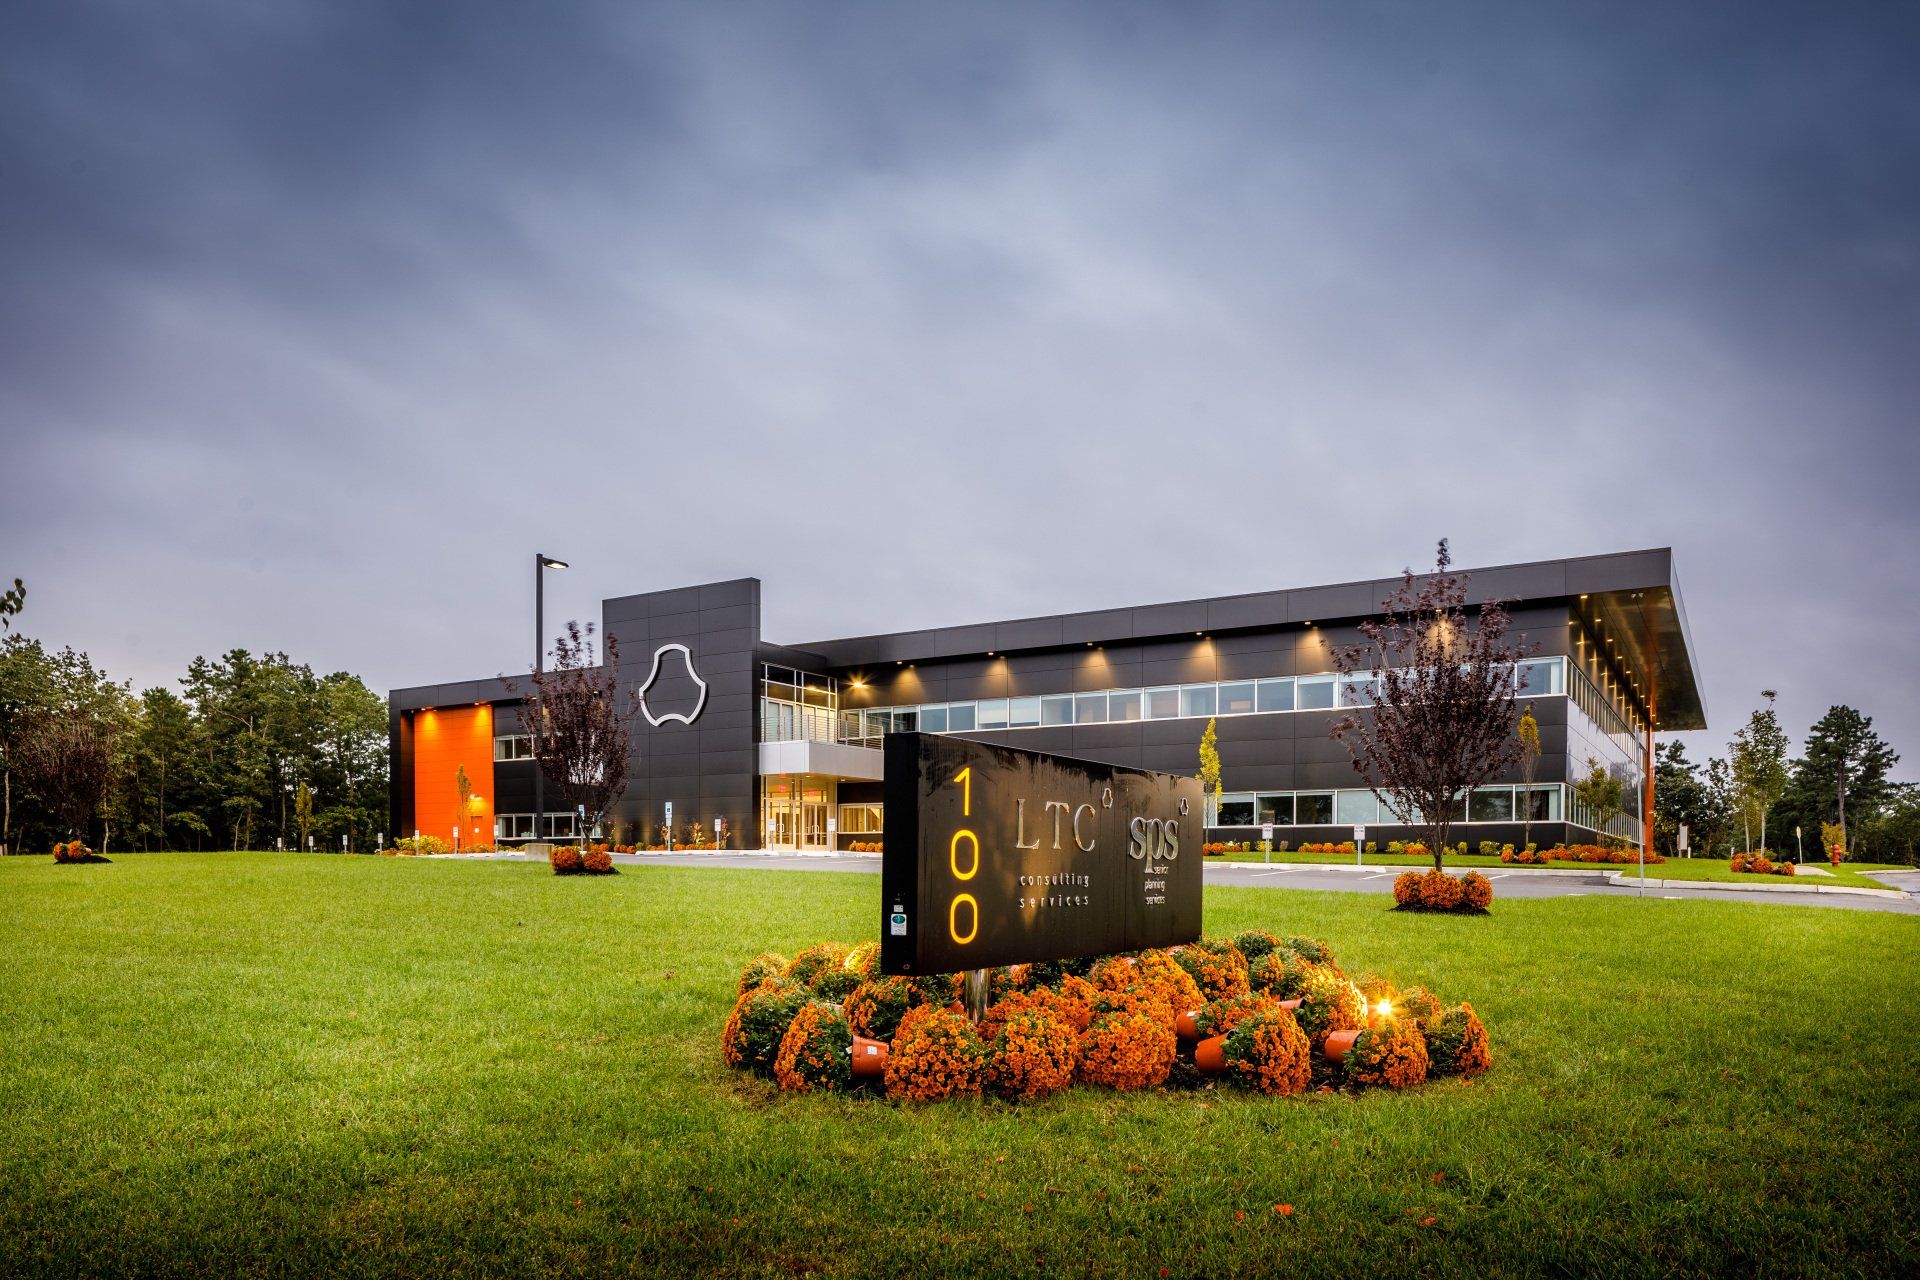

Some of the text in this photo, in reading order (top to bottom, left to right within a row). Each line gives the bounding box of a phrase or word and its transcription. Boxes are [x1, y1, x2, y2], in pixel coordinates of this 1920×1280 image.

[1016, 799, 1096, 852] LTC
[950, 768, 979, 944] 100
[1020, 873, 1089, 888] consulting
[1144, 879, 1166, 892] planning
[1019, 895, 1089, 909] services
[1146, 894, 1166, 905] services
